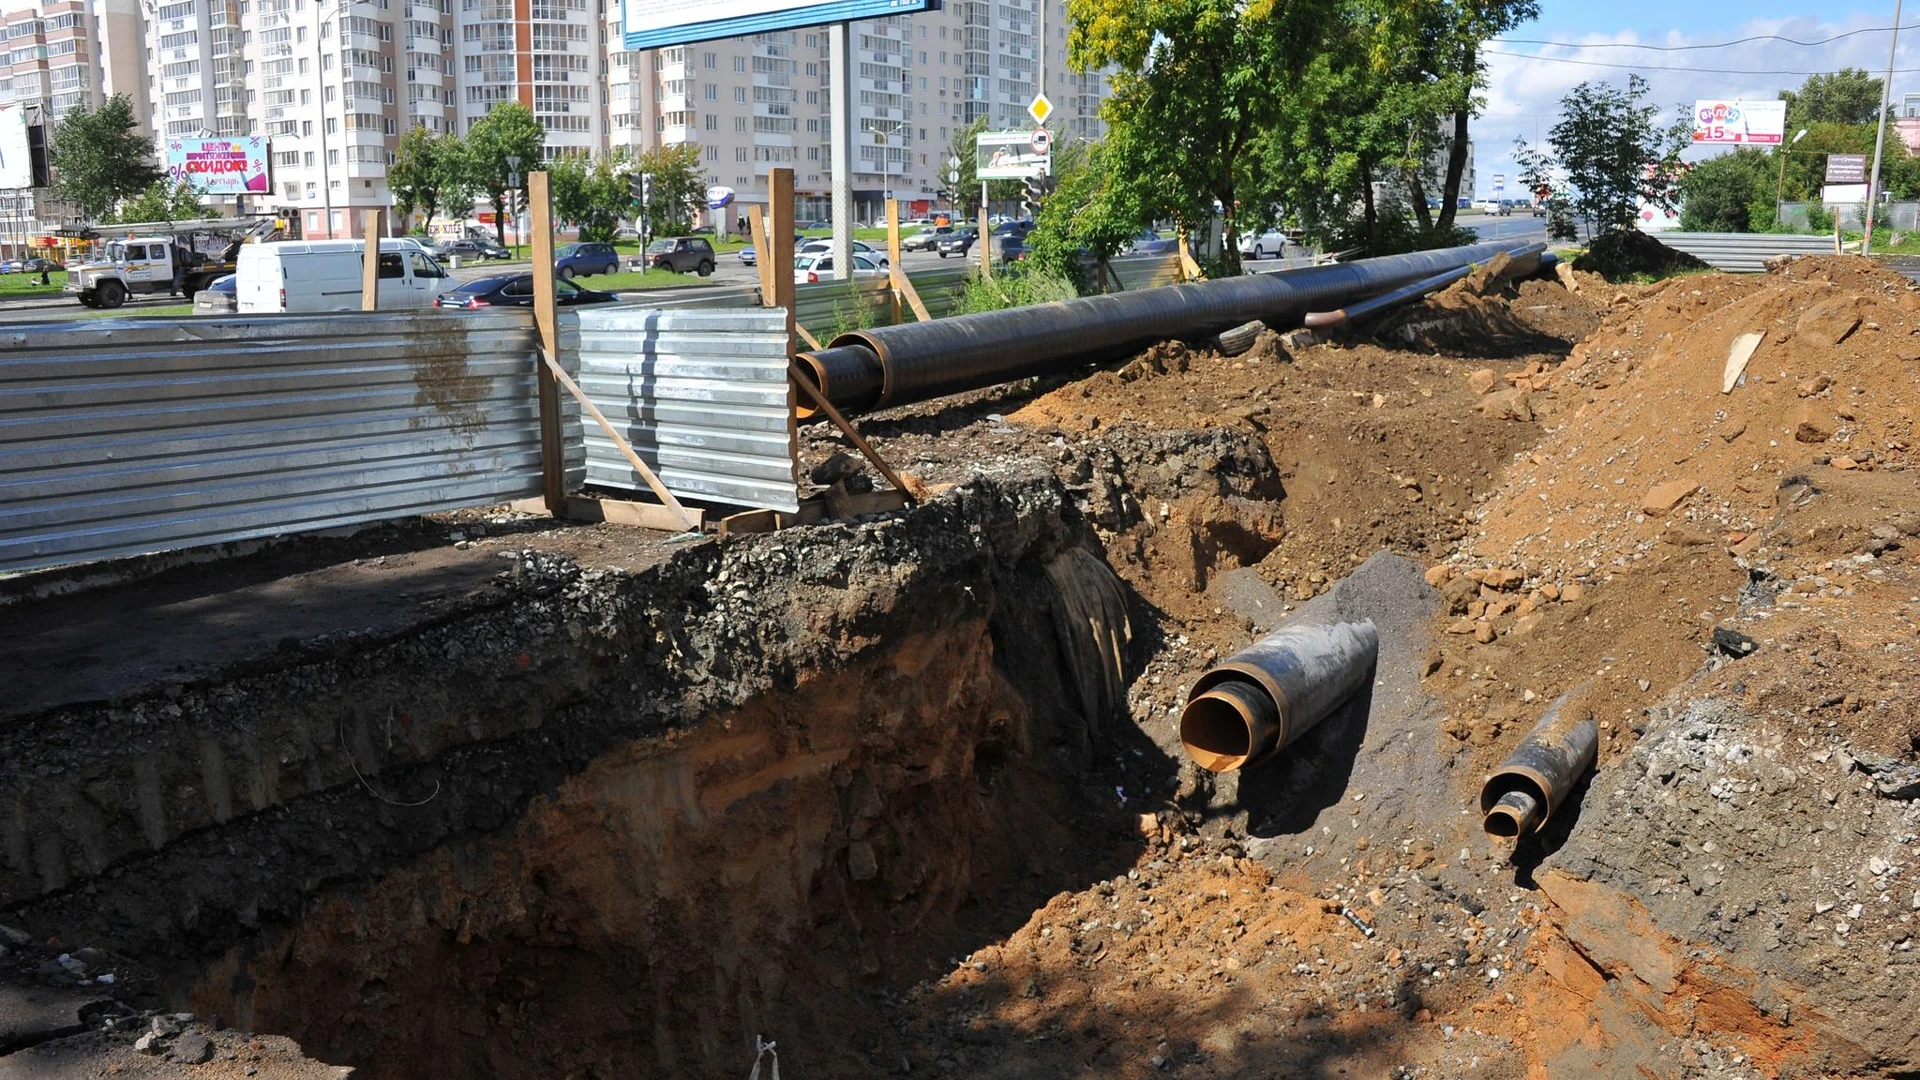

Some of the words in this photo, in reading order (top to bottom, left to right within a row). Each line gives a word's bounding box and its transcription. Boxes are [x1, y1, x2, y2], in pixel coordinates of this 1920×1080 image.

[1700, 107, 1739, 120] ВКЛАД
[1705, 126, 1735, 139] 15%
[201, 142, 231, 152] ЦЕНТР
[186, 160, 247, 174] СКИДОК!
